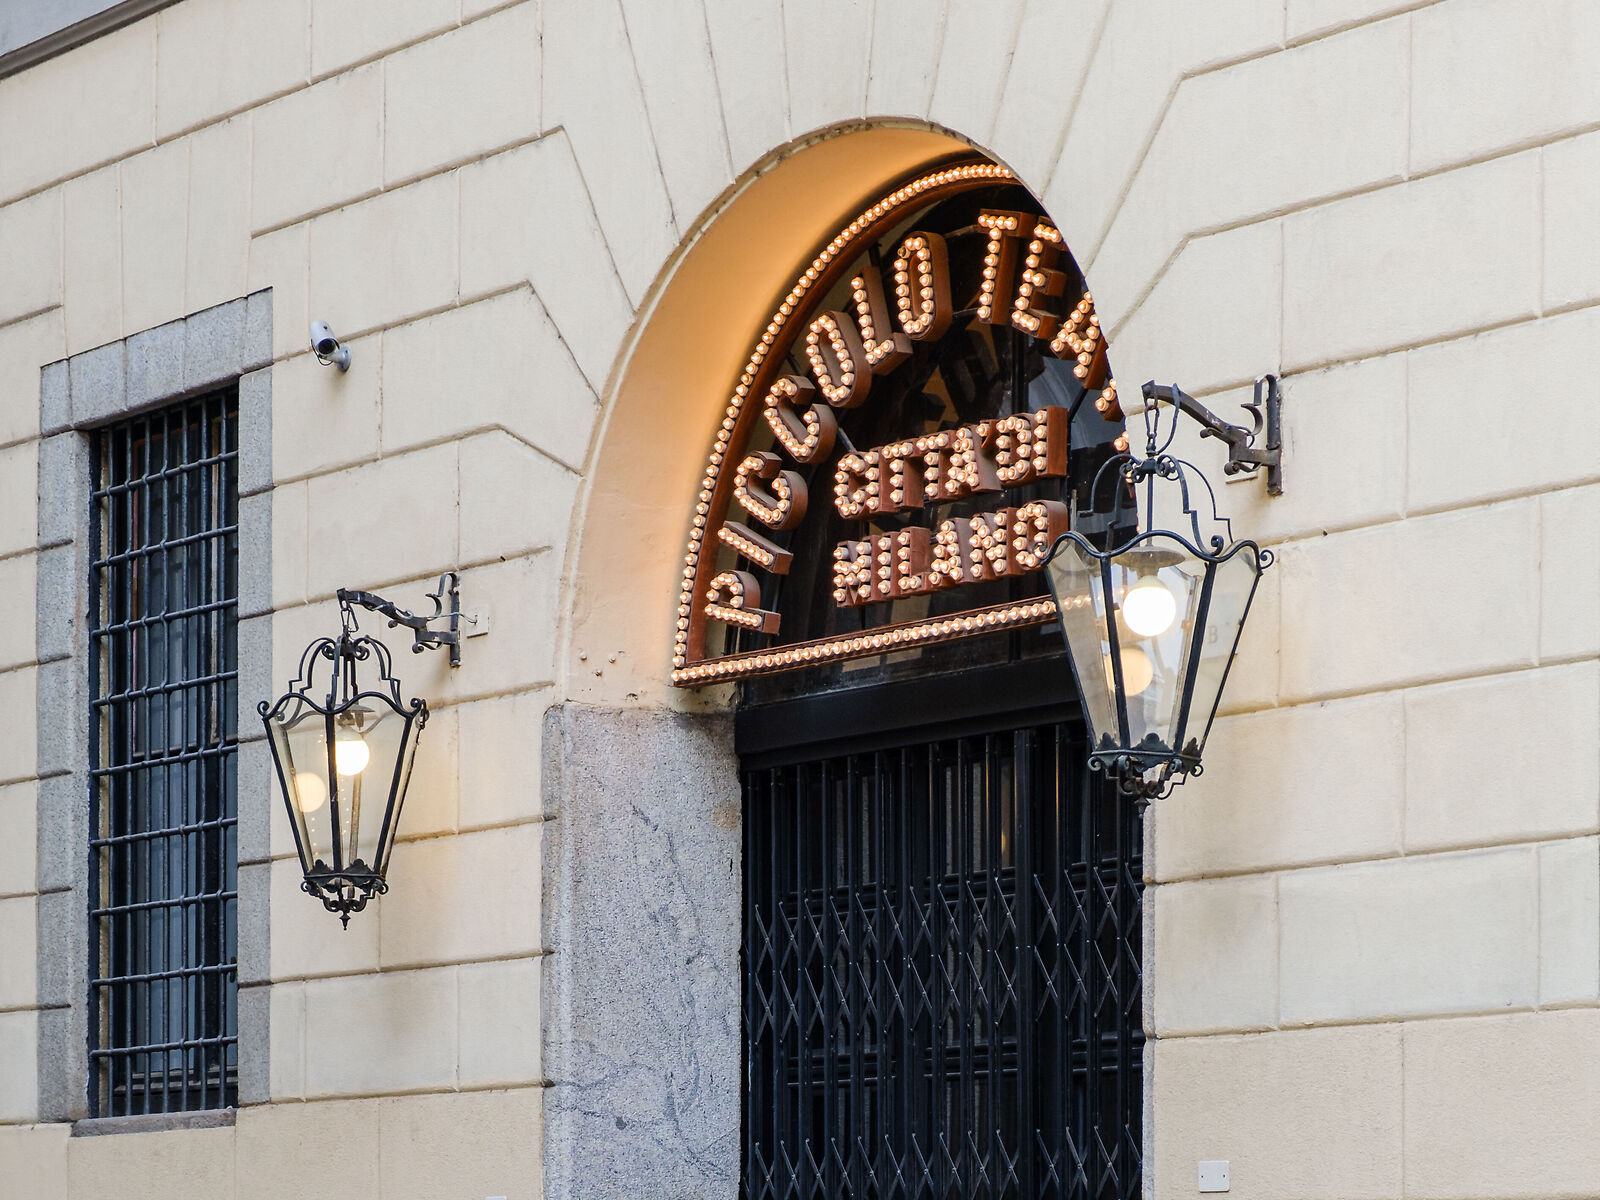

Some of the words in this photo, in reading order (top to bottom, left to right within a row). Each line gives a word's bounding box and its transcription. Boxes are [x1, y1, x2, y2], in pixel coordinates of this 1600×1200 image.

[704, 230, 953, 634] PICCOLO
[996, 407, 1068, 486] DI
[833, 500, 1068, 608] MILANO
